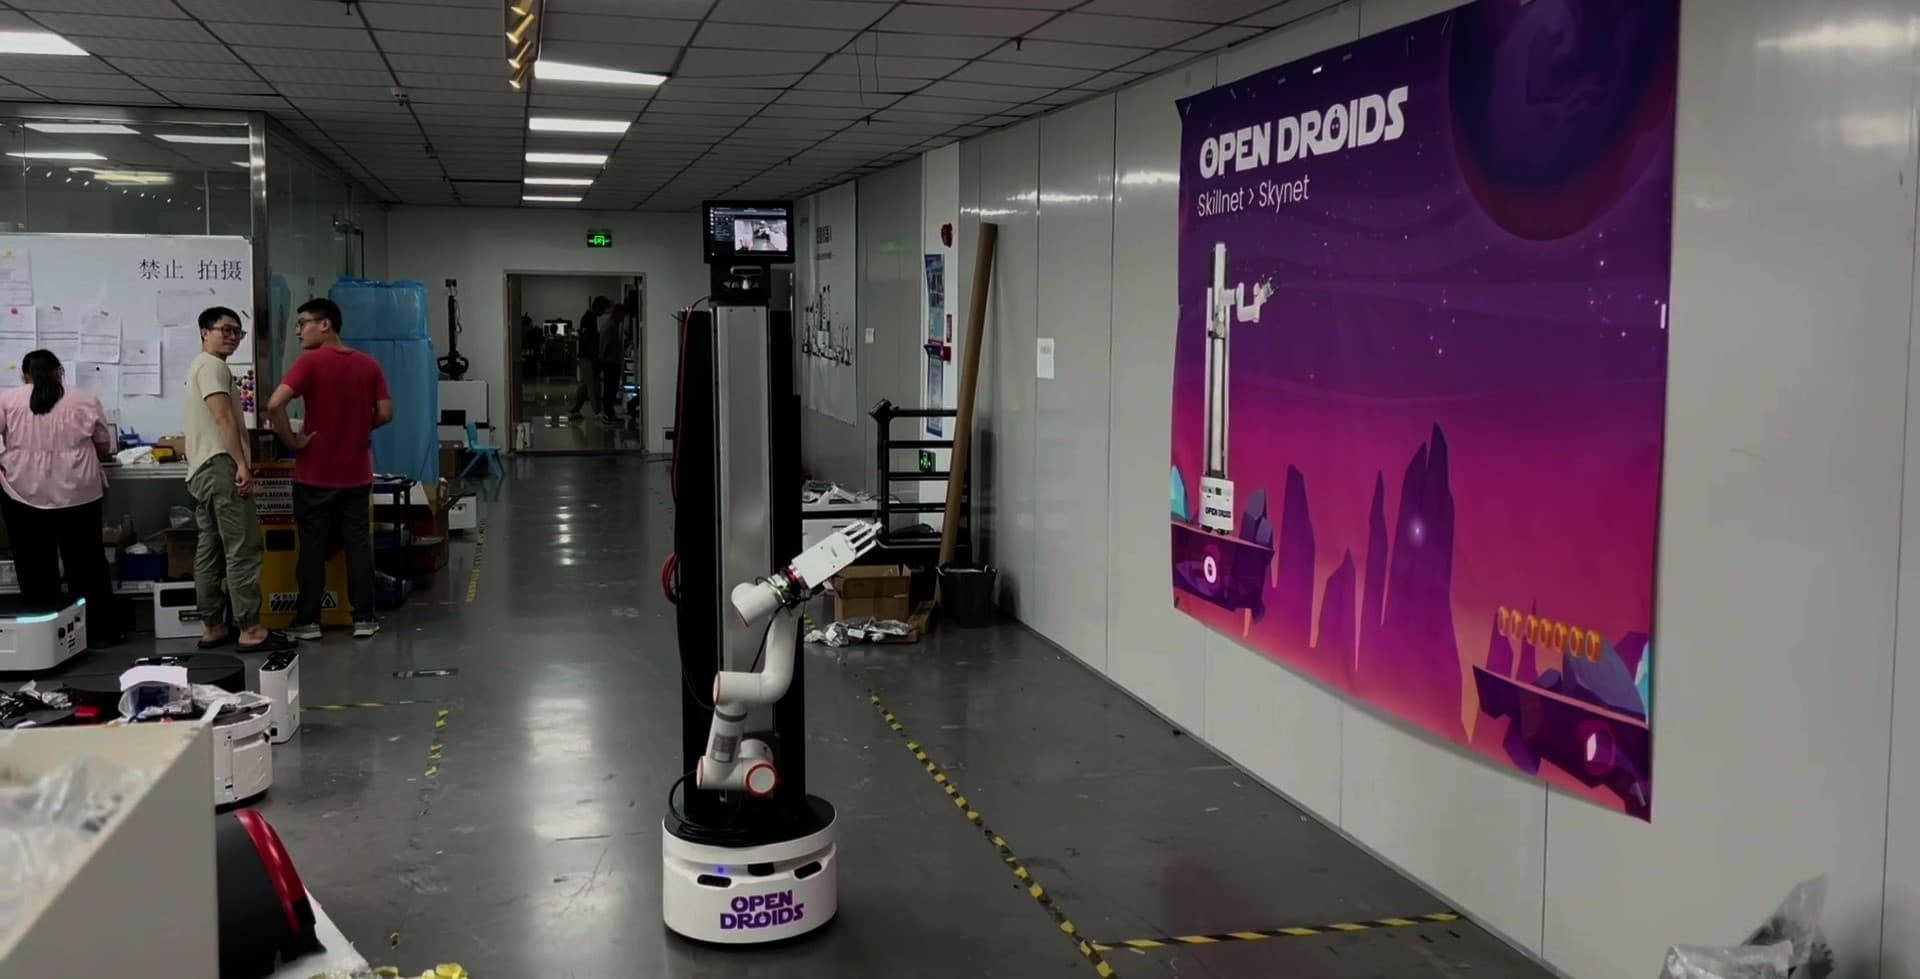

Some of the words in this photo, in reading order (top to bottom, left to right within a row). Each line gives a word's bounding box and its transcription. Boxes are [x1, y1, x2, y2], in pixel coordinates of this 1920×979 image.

[1199, 121, 1271, 179] OPEN
[1277, 85, 1409, 164] DROIDS
[1197, 189, 1244, 217] Skillnet
[1259, 174, 1310, 214] Skynet
[138, 258, 184, 281] 禁止
[197, 258, 243, 281] 拍摄
[731, 889, 792, 912] OPEN
[720, 902, 804, 929] DROIDS
